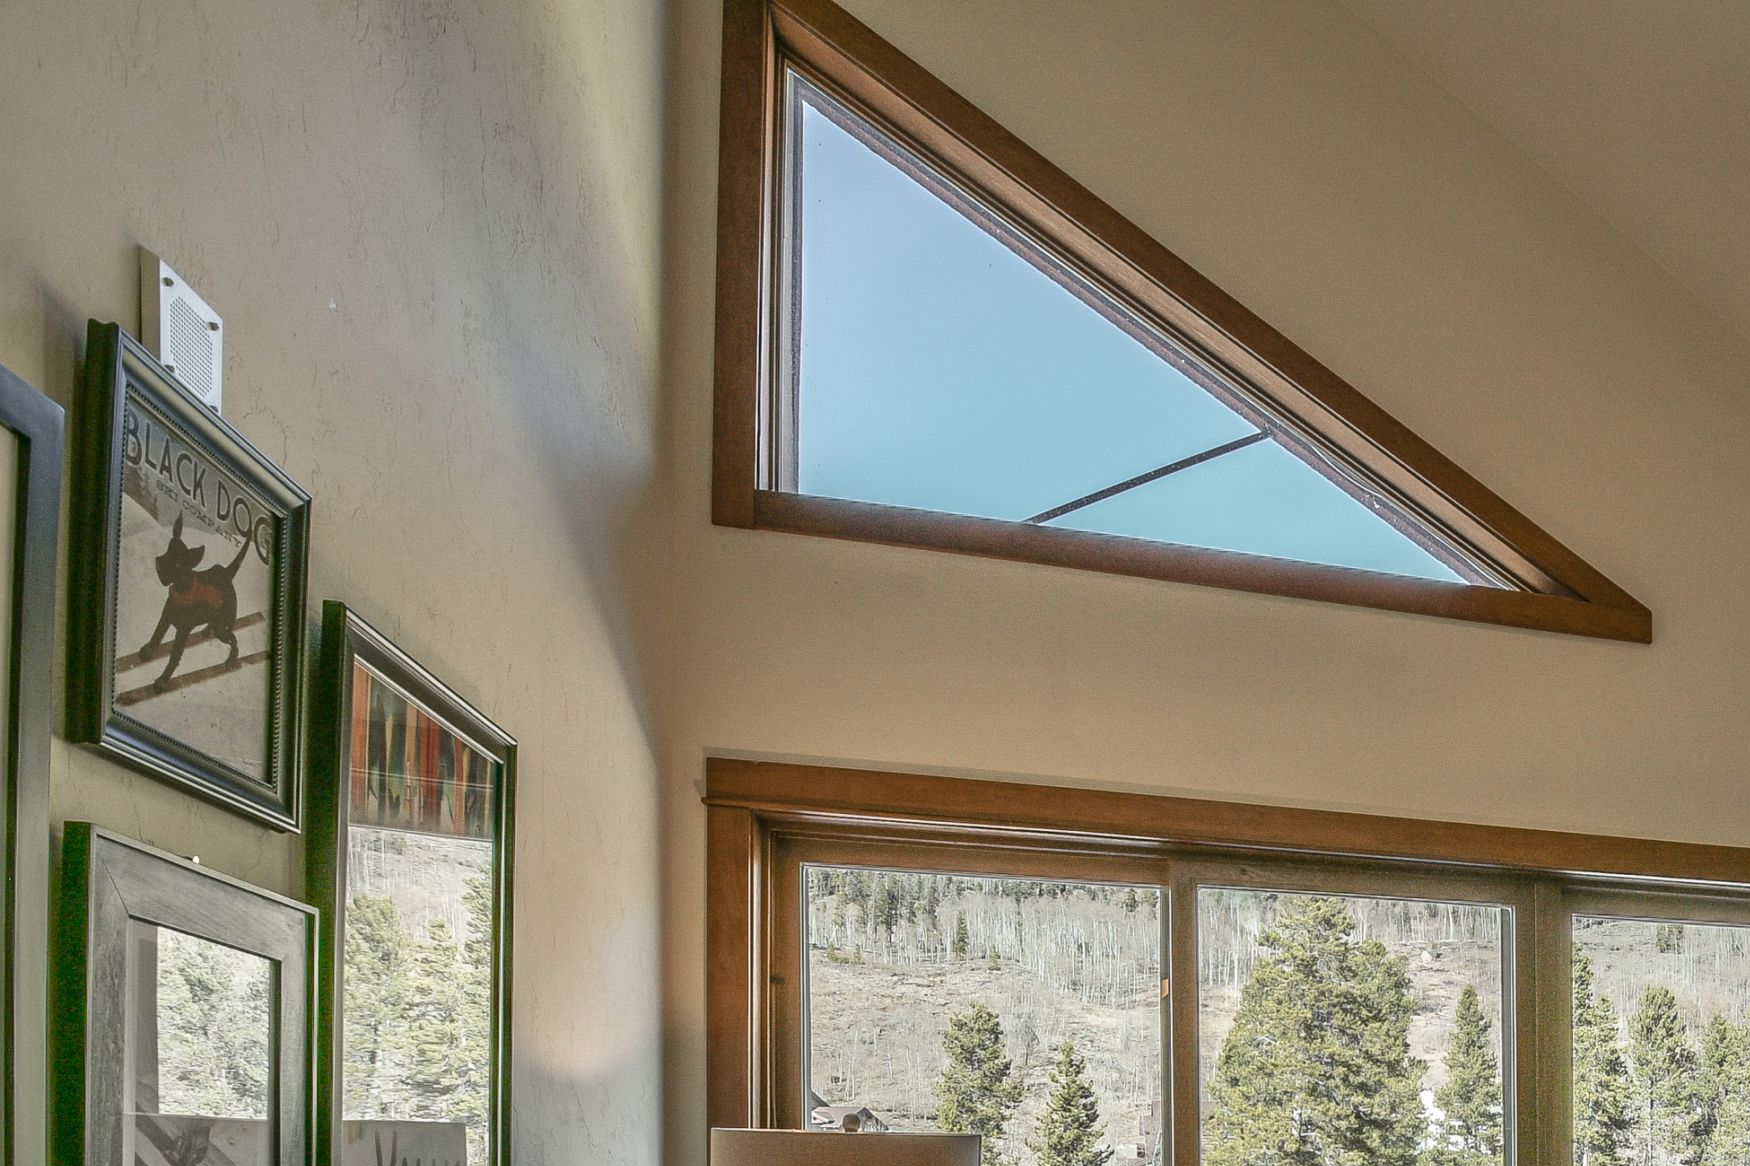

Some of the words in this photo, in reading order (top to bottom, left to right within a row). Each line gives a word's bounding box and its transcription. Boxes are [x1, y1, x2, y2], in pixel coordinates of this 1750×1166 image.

[125, 408, 207, 508] BLACK
[217, 479, 272, 566] DOG
[156, 478, 179, 503] SKI
[182, 499, 242, 548] COMPANY
